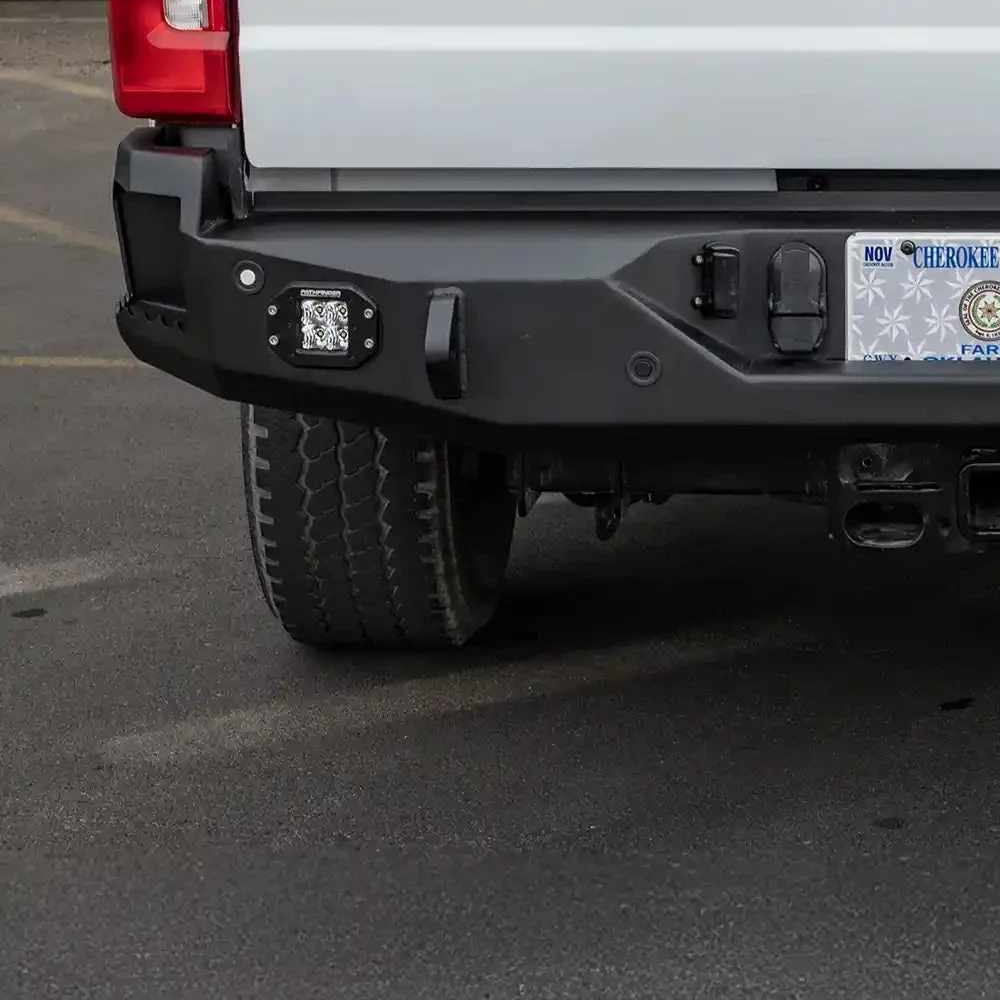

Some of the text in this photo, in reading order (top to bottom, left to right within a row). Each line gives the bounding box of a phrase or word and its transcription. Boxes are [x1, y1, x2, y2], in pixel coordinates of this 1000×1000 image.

[865, 246, 893, 262] NOV
[913, 245, 999, 268] CHEROKEE
[300, 289, 341, 298] PATHFINDER
